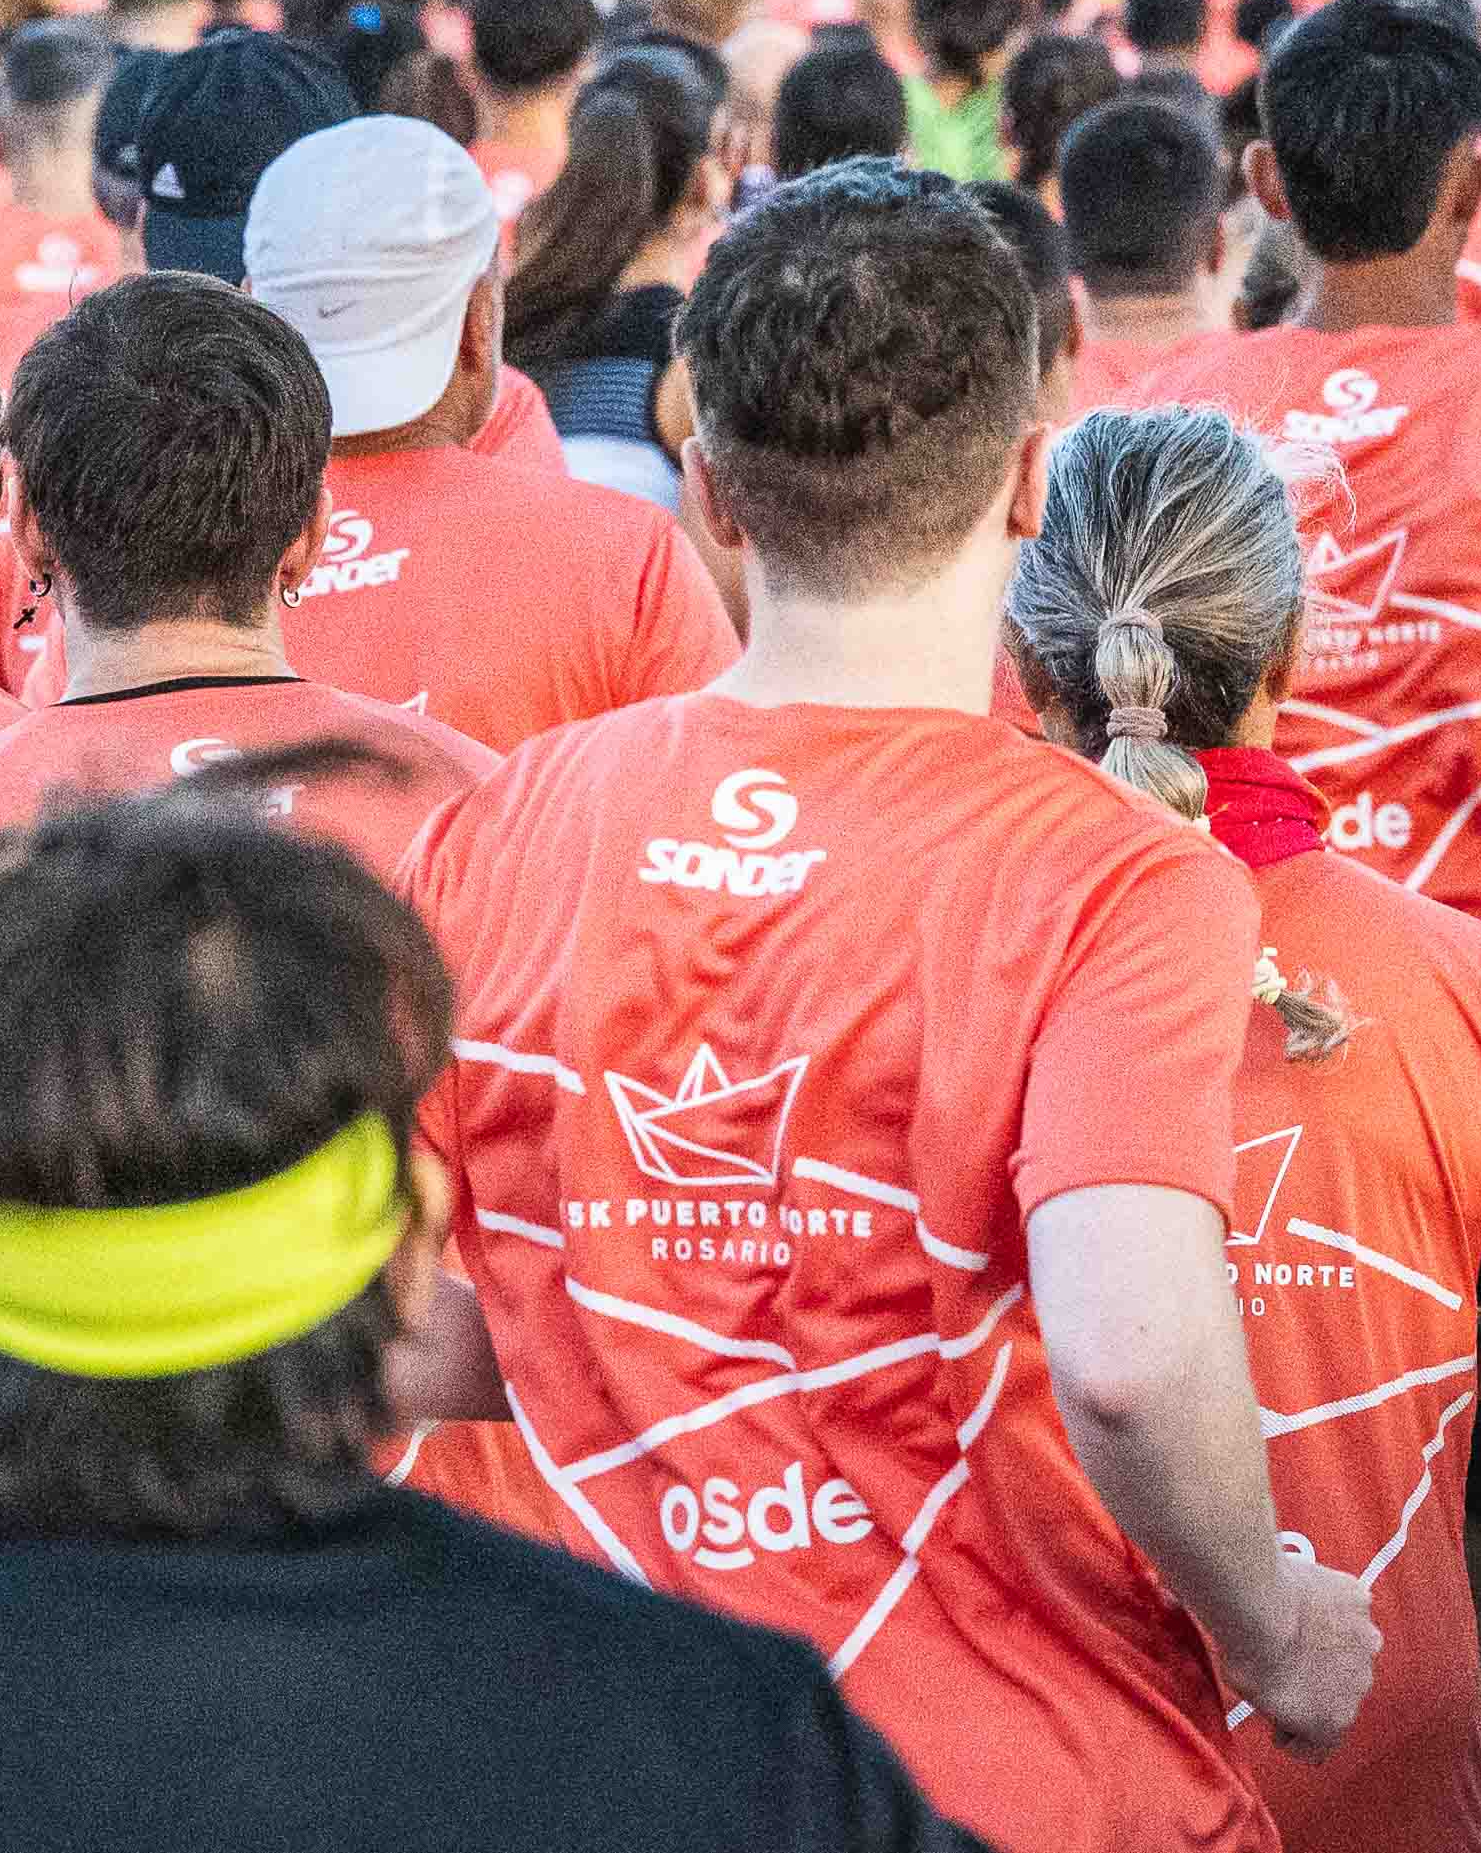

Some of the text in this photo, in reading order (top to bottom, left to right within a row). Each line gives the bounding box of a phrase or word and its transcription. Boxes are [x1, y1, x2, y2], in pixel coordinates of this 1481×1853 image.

[626, 1199, 767, 1229] PUERTO
[651, 1238, 791, 1266] ROSARIO
[1255, 1262, 1355, 1288] NORTE
[660, 1461, 875, 1571] osde
